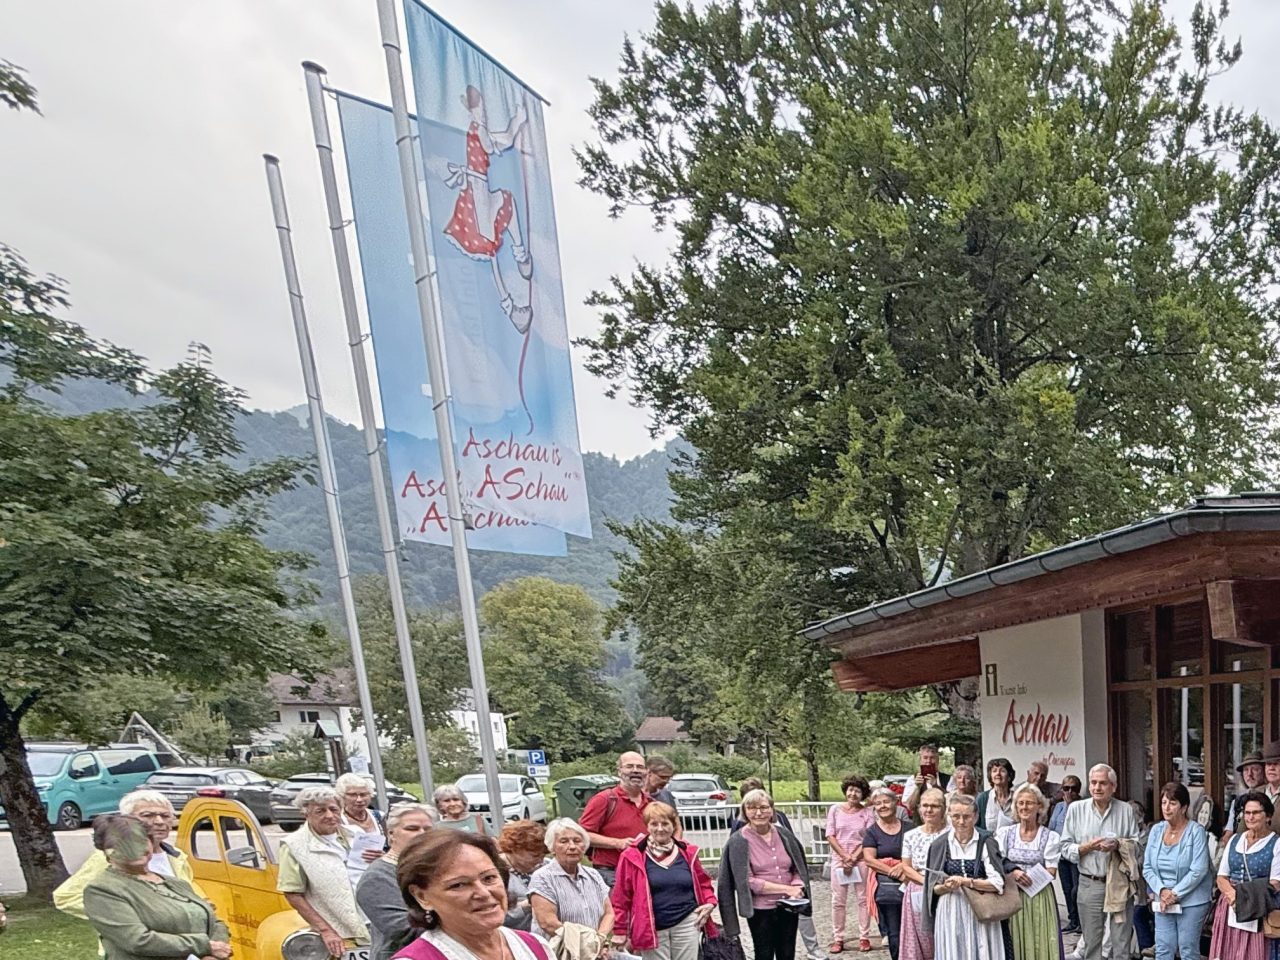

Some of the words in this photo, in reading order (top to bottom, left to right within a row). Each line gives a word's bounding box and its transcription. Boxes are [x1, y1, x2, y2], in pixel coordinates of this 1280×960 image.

[462, 426, 548, 463] Aschau
[1002, 698, 1071, 745] Aschau
[531, 752, 541, 764] P
